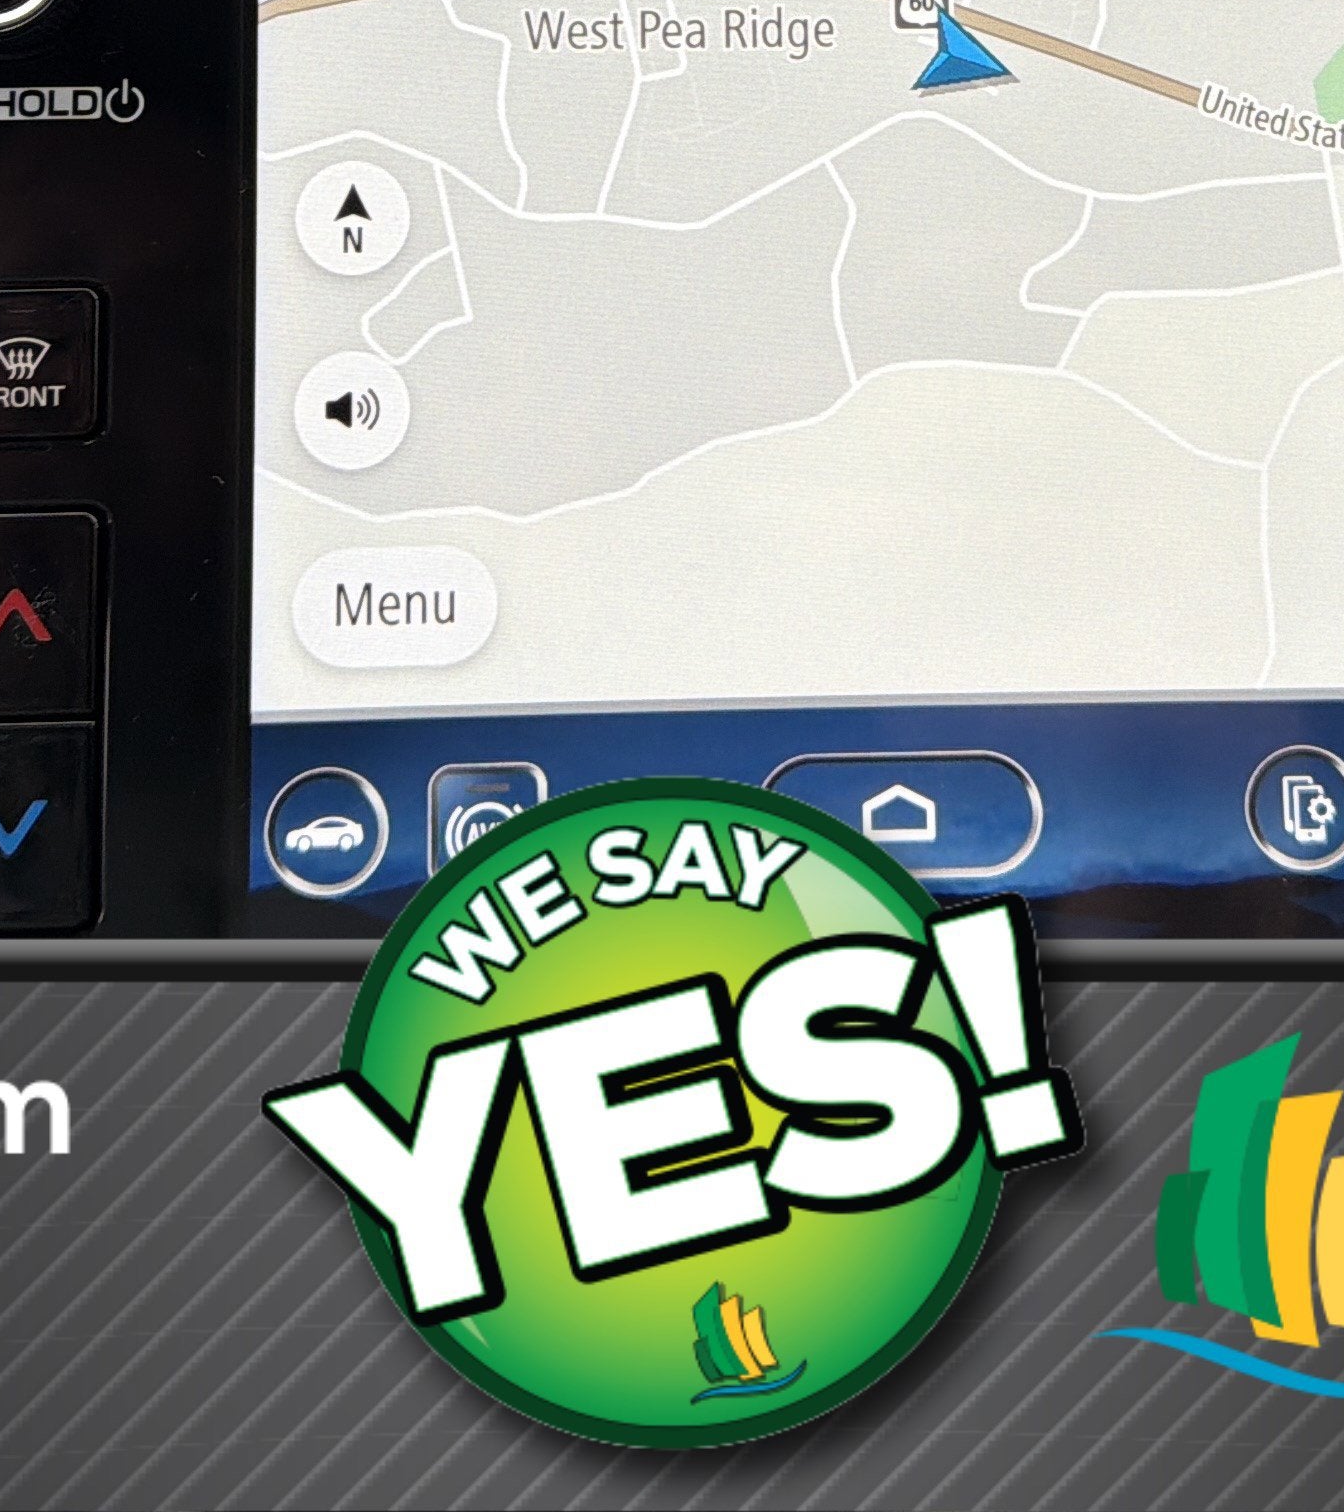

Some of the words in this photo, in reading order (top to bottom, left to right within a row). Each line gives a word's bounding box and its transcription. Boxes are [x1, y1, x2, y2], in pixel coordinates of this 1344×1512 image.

[524, 10, 624, 50] West
[640, 10, 706, 50] Pea
[724, 6, 834, 60] Ridge
[1202, 85, 1290, 136] United
[342, 226, 363, 254] N
[335, 582, 456, 627] Menu
